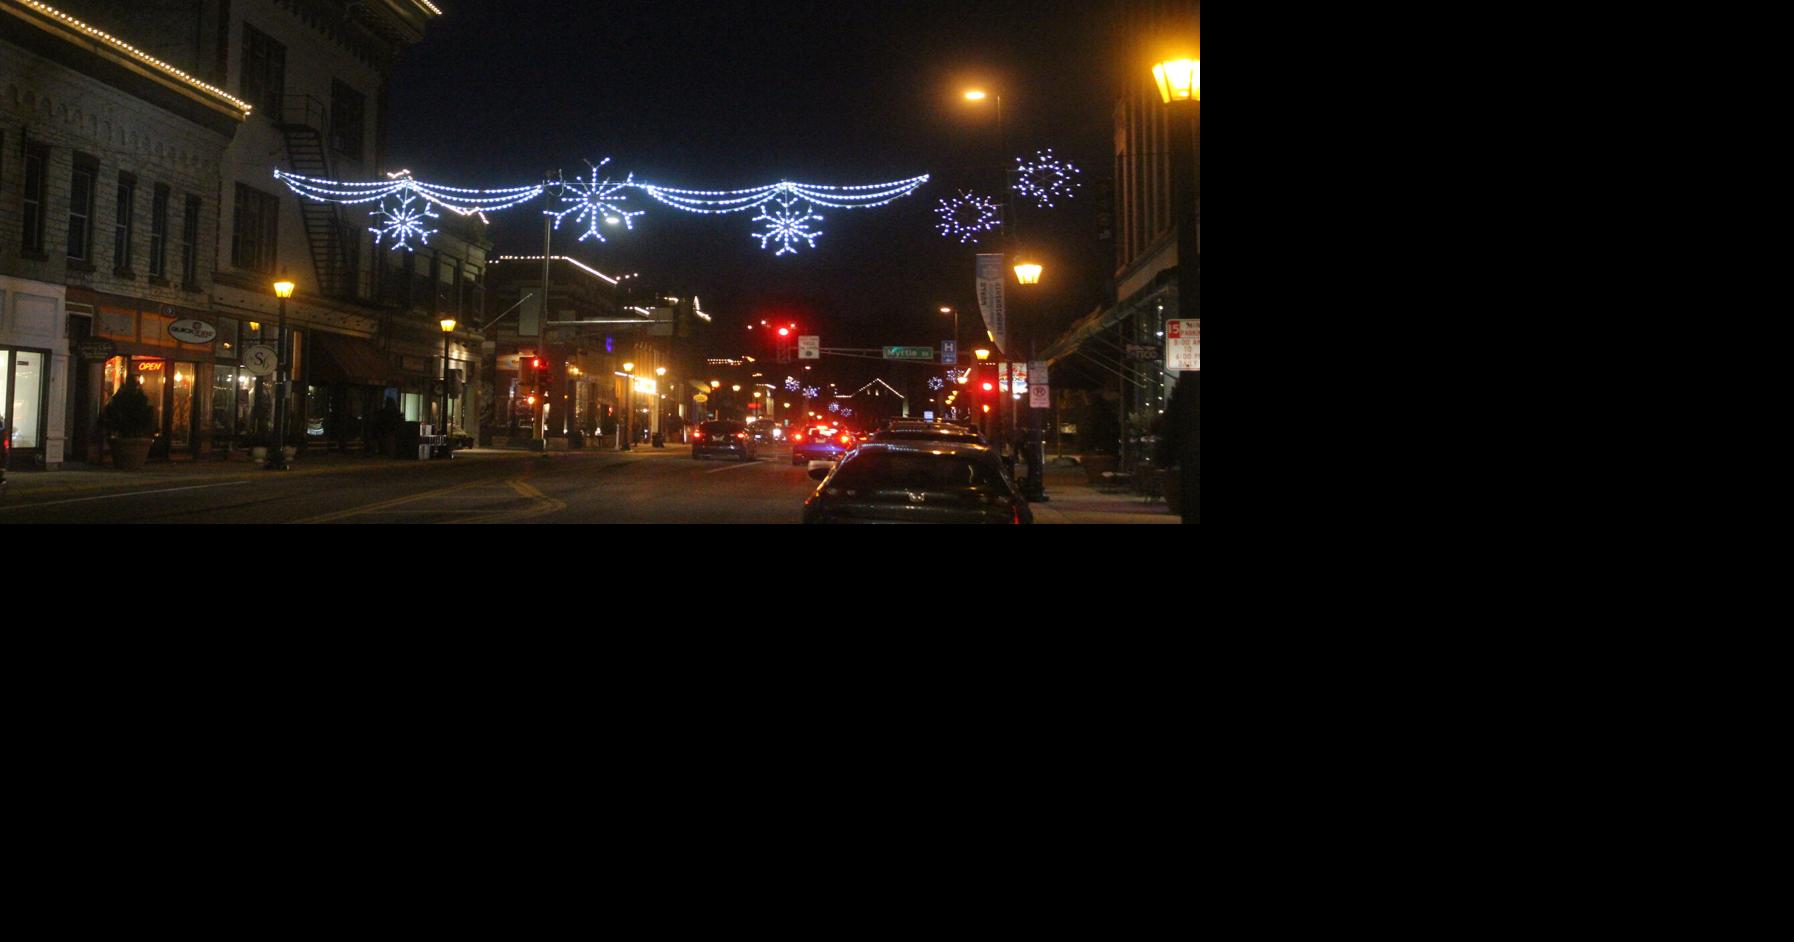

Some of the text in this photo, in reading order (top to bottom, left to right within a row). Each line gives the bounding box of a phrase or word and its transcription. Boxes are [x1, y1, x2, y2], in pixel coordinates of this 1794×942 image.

[1168, 324, 1179, 334] 15
[887, 347, 917, 357] Myrtle
[944, 343, 953, 352] H
[139, 363, 161, 371] OPEN
